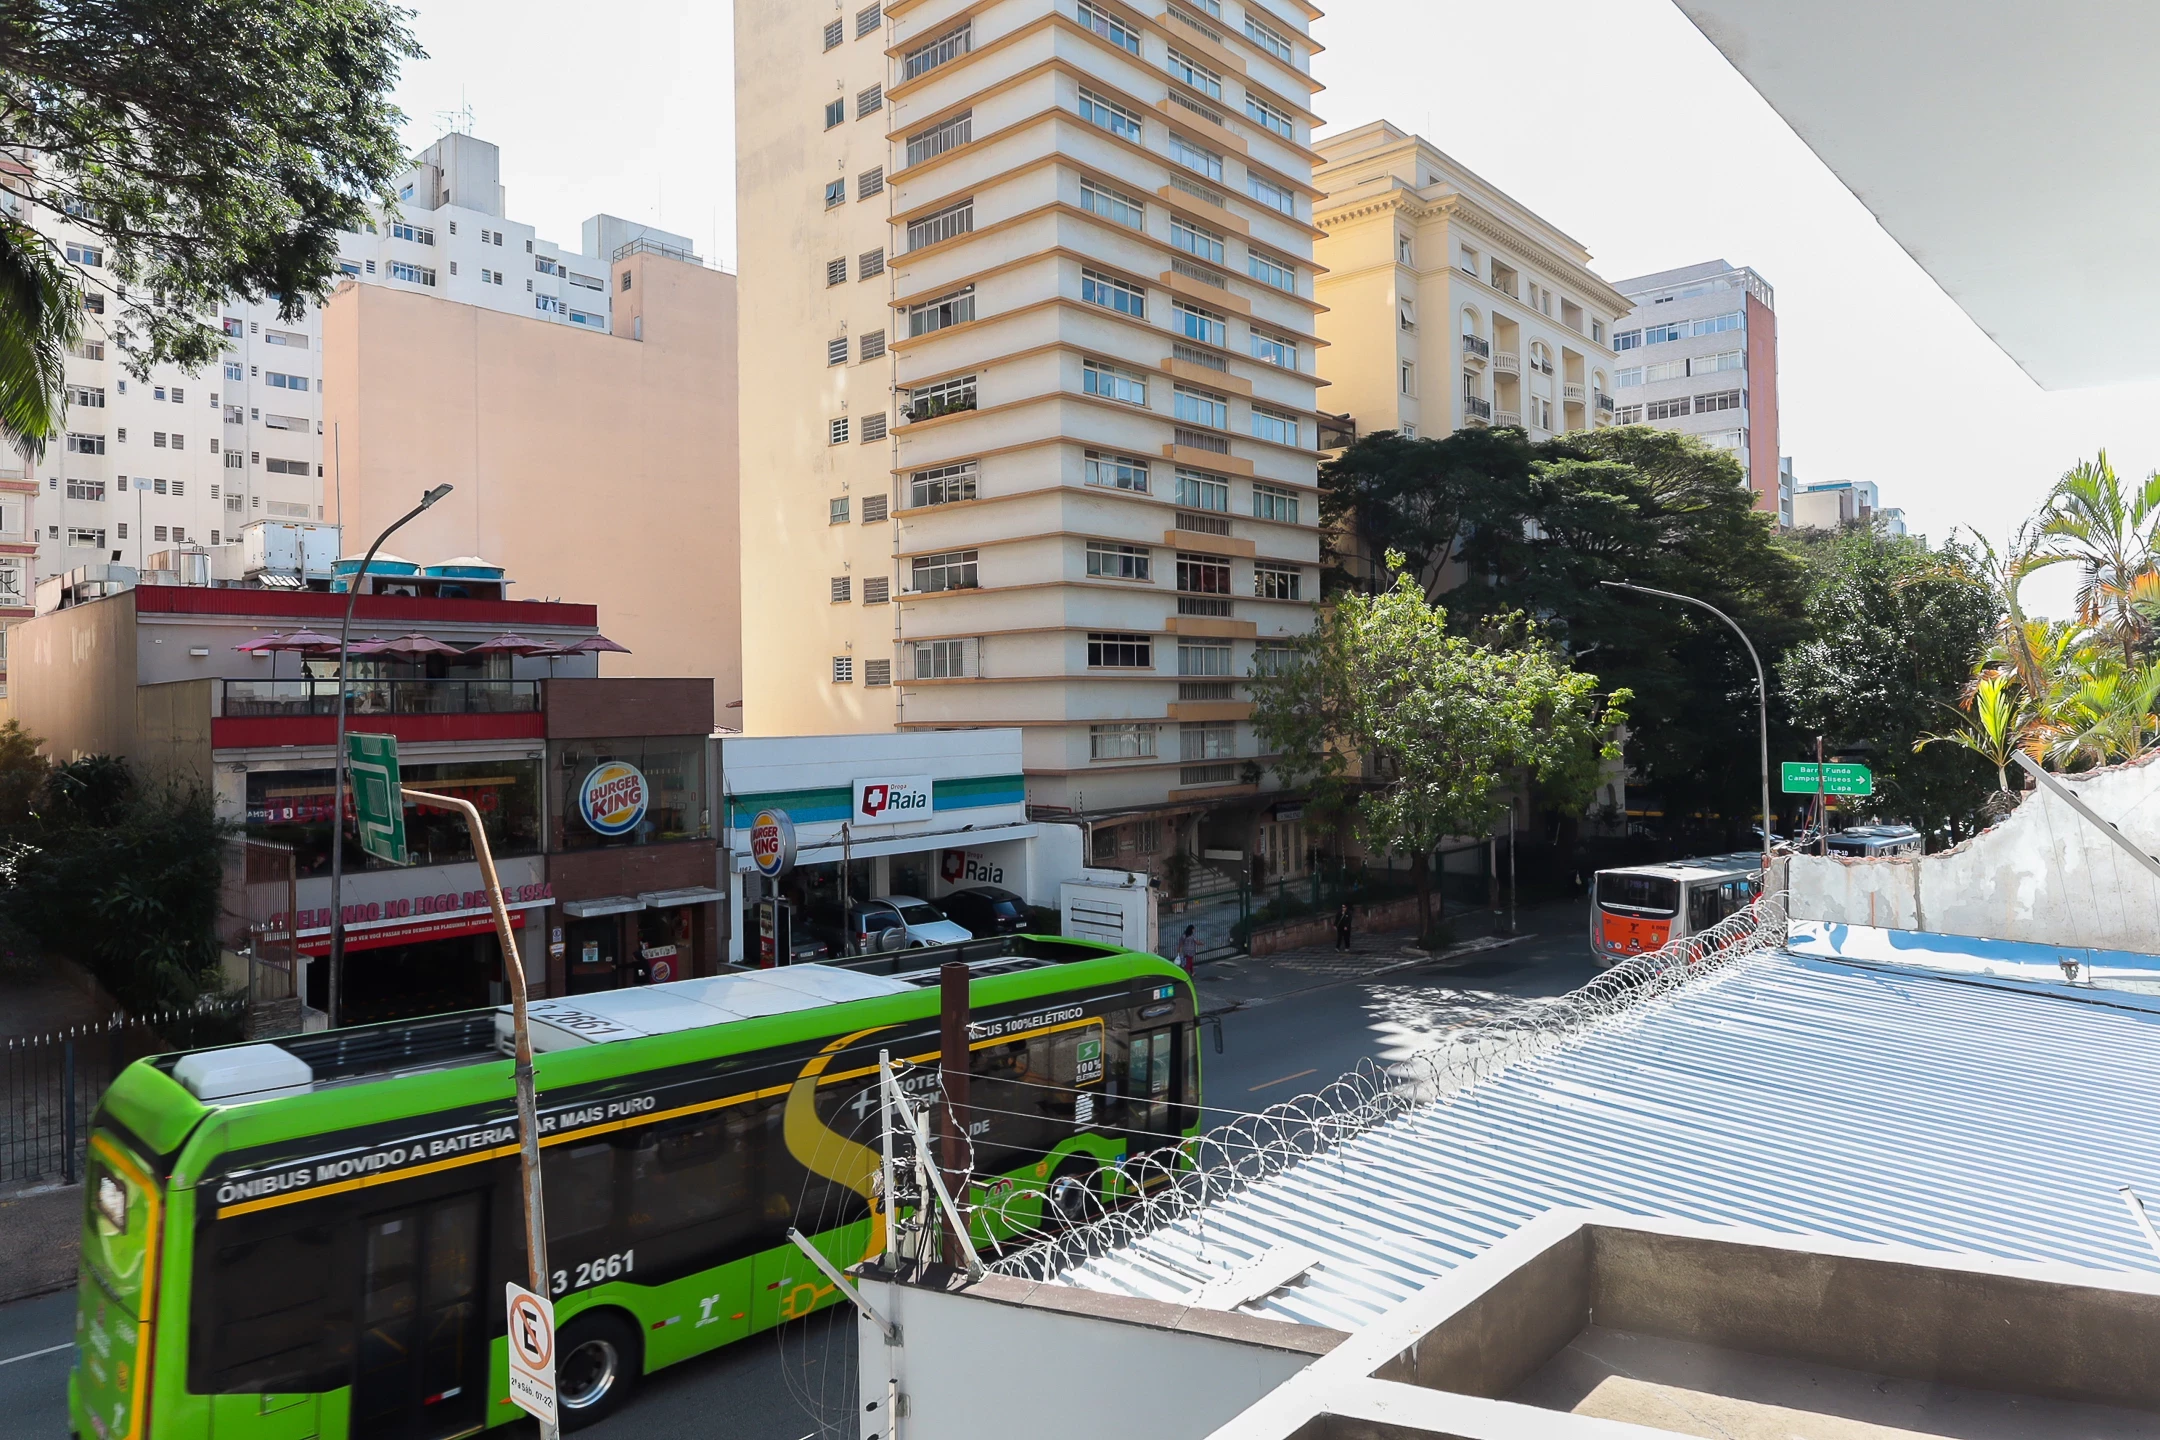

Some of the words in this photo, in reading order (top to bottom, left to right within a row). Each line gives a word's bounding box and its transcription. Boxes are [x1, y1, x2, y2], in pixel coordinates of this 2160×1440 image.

[590, 774, 639, 803] BURGER
[1788, 775, 1820, 783] Campos
[592, 786, 641, 820] KING
[888, 791, 926, 810] Raia
[752, 826, 778, 840] BURGER
[753, 837, 778, 855] KING
[967, 851, 983, 859] Droga
[965, 860, 1003, 883] Raia
[385, 899, 410, 920] NO
[415, 893, 459, 915] FOGO
[463, 887, 512, 909] DESE
[516, 882, 552, 901] 1954
[298, 941, 314, 949] PASSA
[382, 930, 400, 938] PASSAR
[538, 1011, 624, 1035] 2661
[1076, 1060, 1101, 1074] 100%
[216, 1168, 311, 1203] ÔNIBUS
[316, 1149, 407, 1182] MOVIDO
[409, 1144, 427, 1161] A
[429, 1126, 516, 1157] BATERIA
[560, 1106, 604, 1128] MAIS
[608, 1096, 656, 1118] PURO
[551, 1269, 568, 1295] 3
[574, 1249, 634, 1288] 2661
[522, 1308, 539, 1355] E
[521, 1382, 534, 1397] Sáb.
